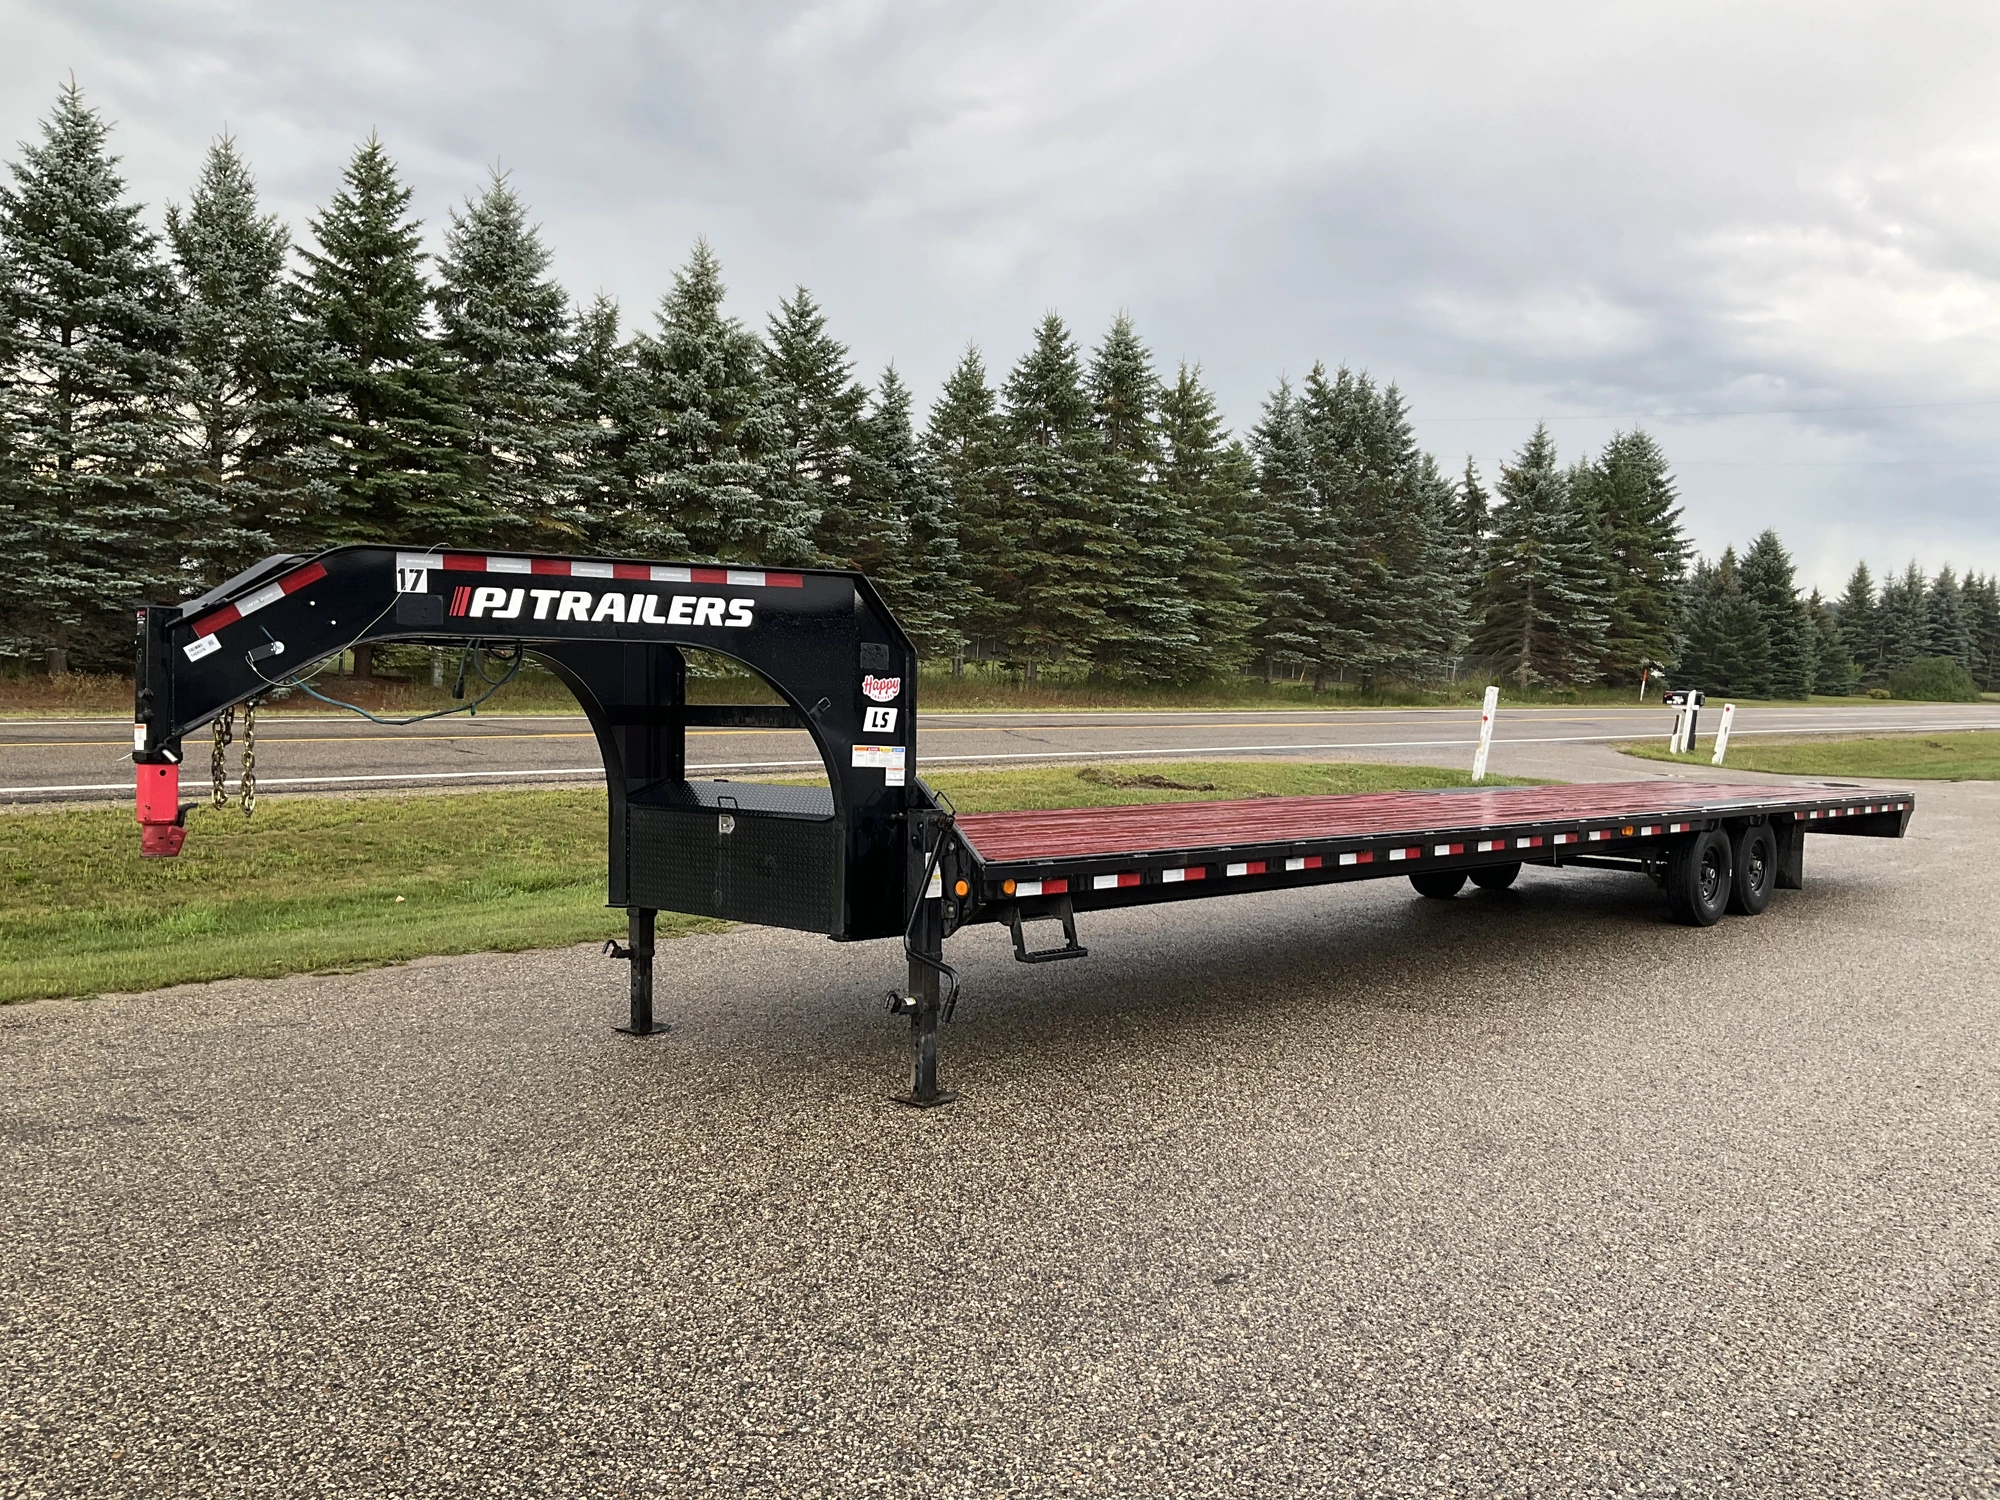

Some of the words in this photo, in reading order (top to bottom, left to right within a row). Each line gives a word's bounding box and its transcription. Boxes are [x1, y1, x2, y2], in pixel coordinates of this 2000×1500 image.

[398, 568, 424, 591] 17
[469, 586, 525, 619] PJ
[530, 589, 755, 628] TRAILERS
[864, 676, 899, 695] Happy
[872, 711, 890, 728] LS
